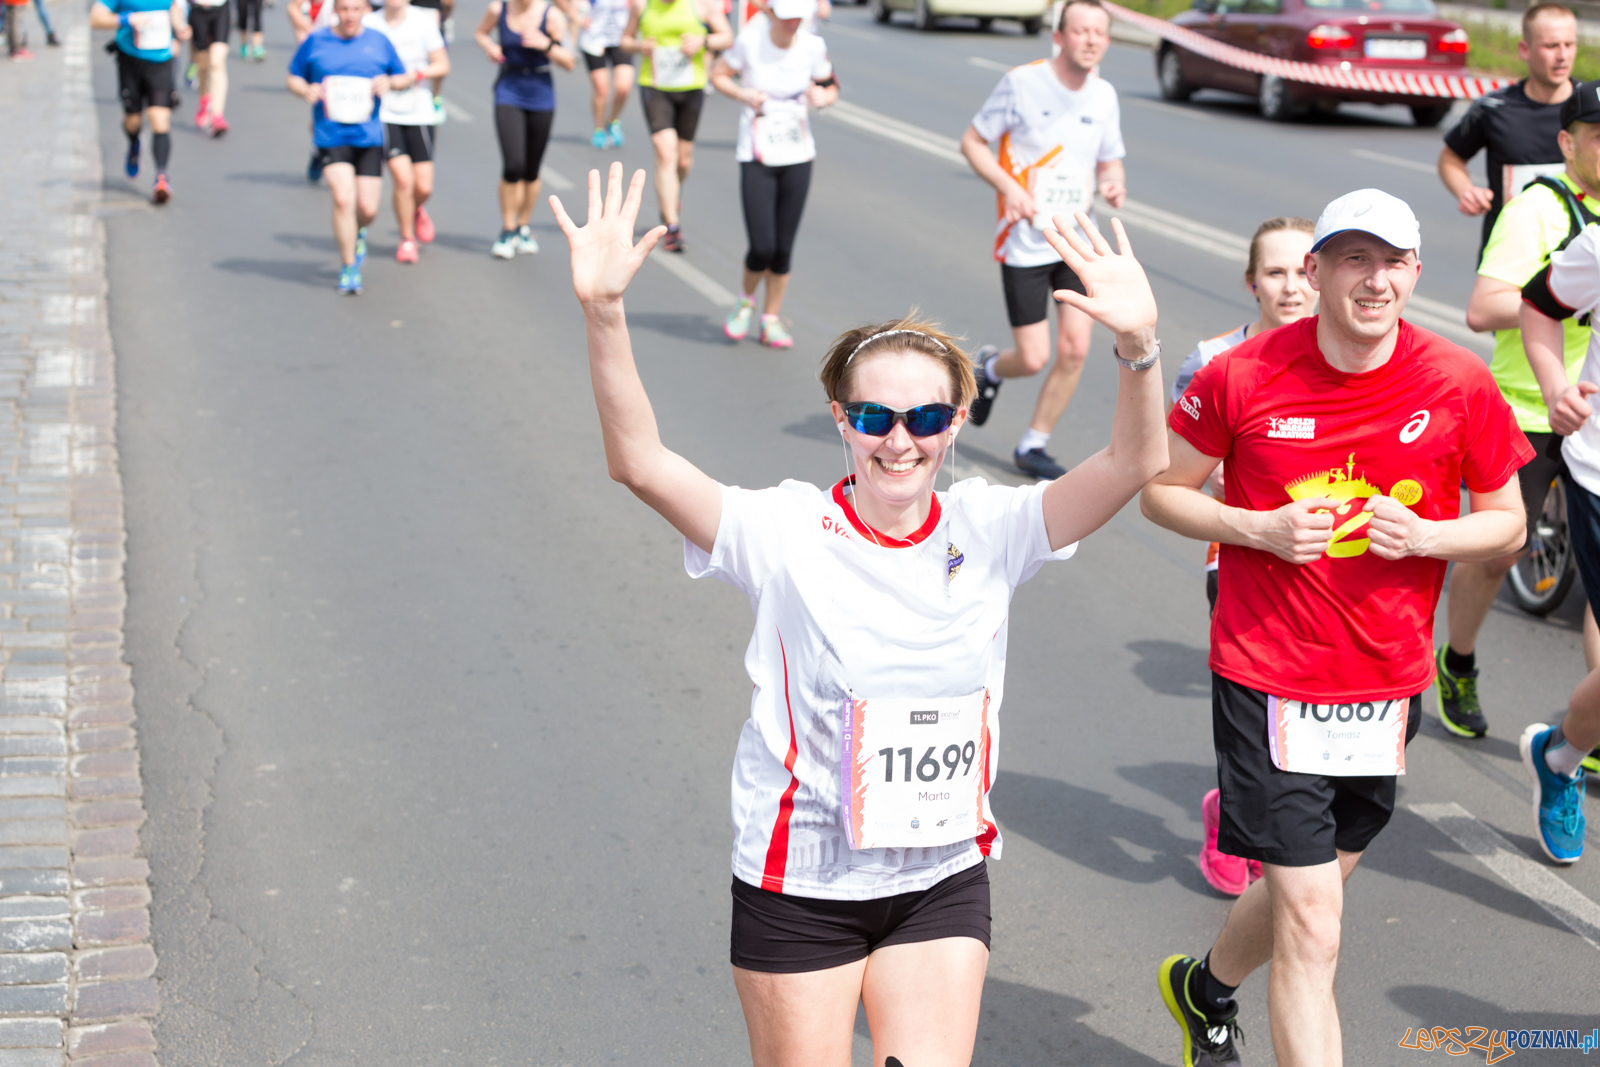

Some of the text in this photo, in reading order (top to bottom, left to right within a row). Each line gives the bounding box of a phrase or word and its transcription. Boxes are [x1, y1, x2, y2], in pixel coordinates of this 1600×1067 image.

[1287, 417, 1315, 426] ORLEN
[1278, 424, 1315, 432] WARSAW
[1267, 430, 1314, 439] MARATHON
[1394, 491, 1416, 502] 2017
[922, 713, 937, 722] PKO
[1326, 730, 1361, 740] Tomasz
[878, 740, 976, 782] 11699
[918, 791, 951, 801] Marta
